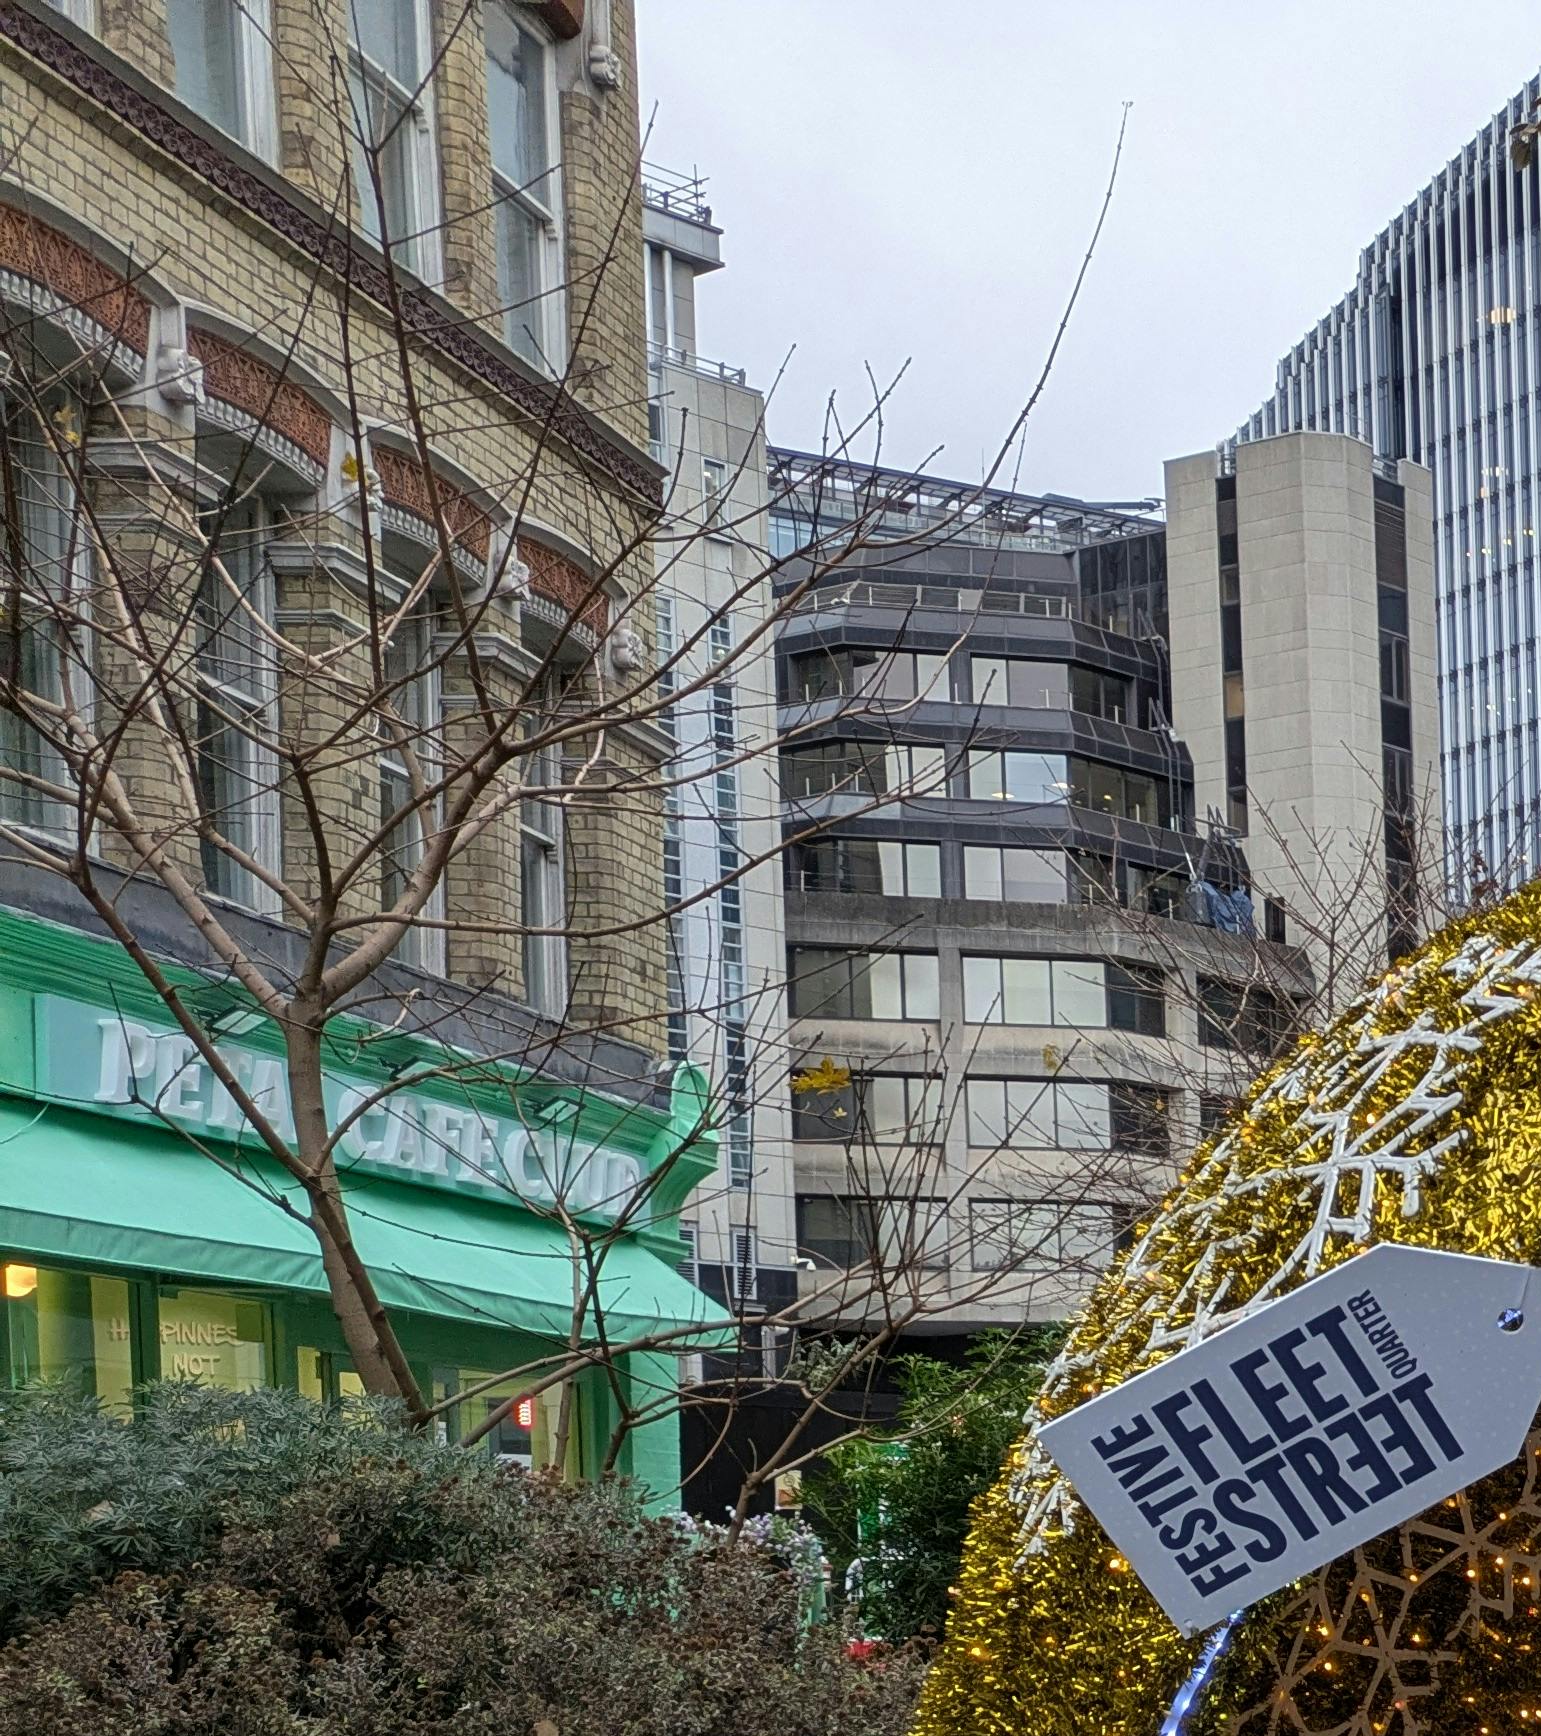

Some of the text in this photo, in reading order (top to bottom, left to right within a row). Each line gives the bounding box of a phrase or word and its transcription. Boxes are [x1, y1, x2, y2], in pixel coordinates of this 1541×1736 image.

[337, 1085, 499, 1188] CAFE
[1151, 1305, 1380, 1485] FLEET
[1347, 1289, 1420, 1379] QUARTER
[1090, 1413, 1252, 1598] FESTIVE
[1213, 1372, 1465, 1563] STREET
